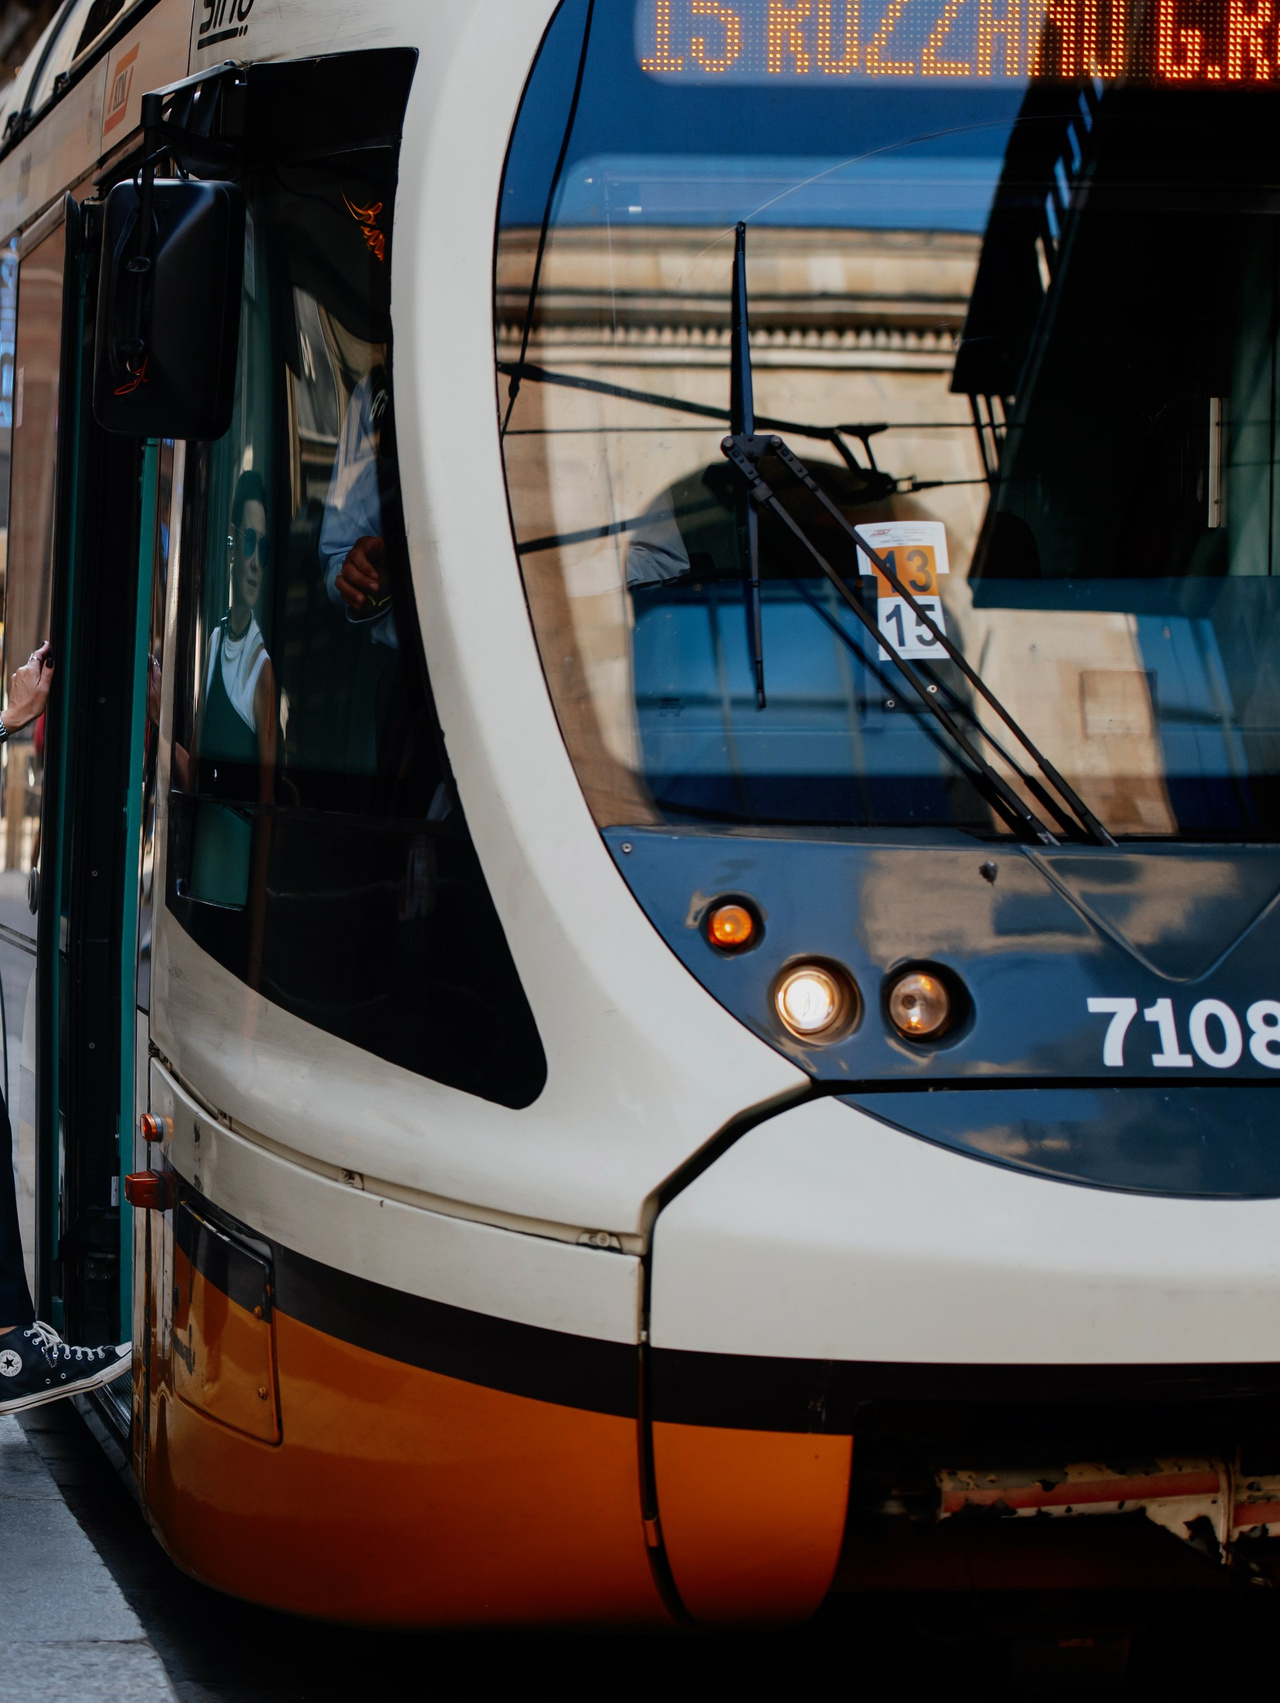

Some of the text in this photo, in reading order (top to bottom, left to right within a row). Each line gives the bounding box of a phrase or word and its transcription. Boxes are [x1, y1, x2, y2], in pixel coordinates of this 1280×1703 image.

[641, 0, 739, 71] 15
[882, 549, 933, 593] 13
[885, 603, 939, 647] 15
[1086, 997, 1280, 1069] 7108
